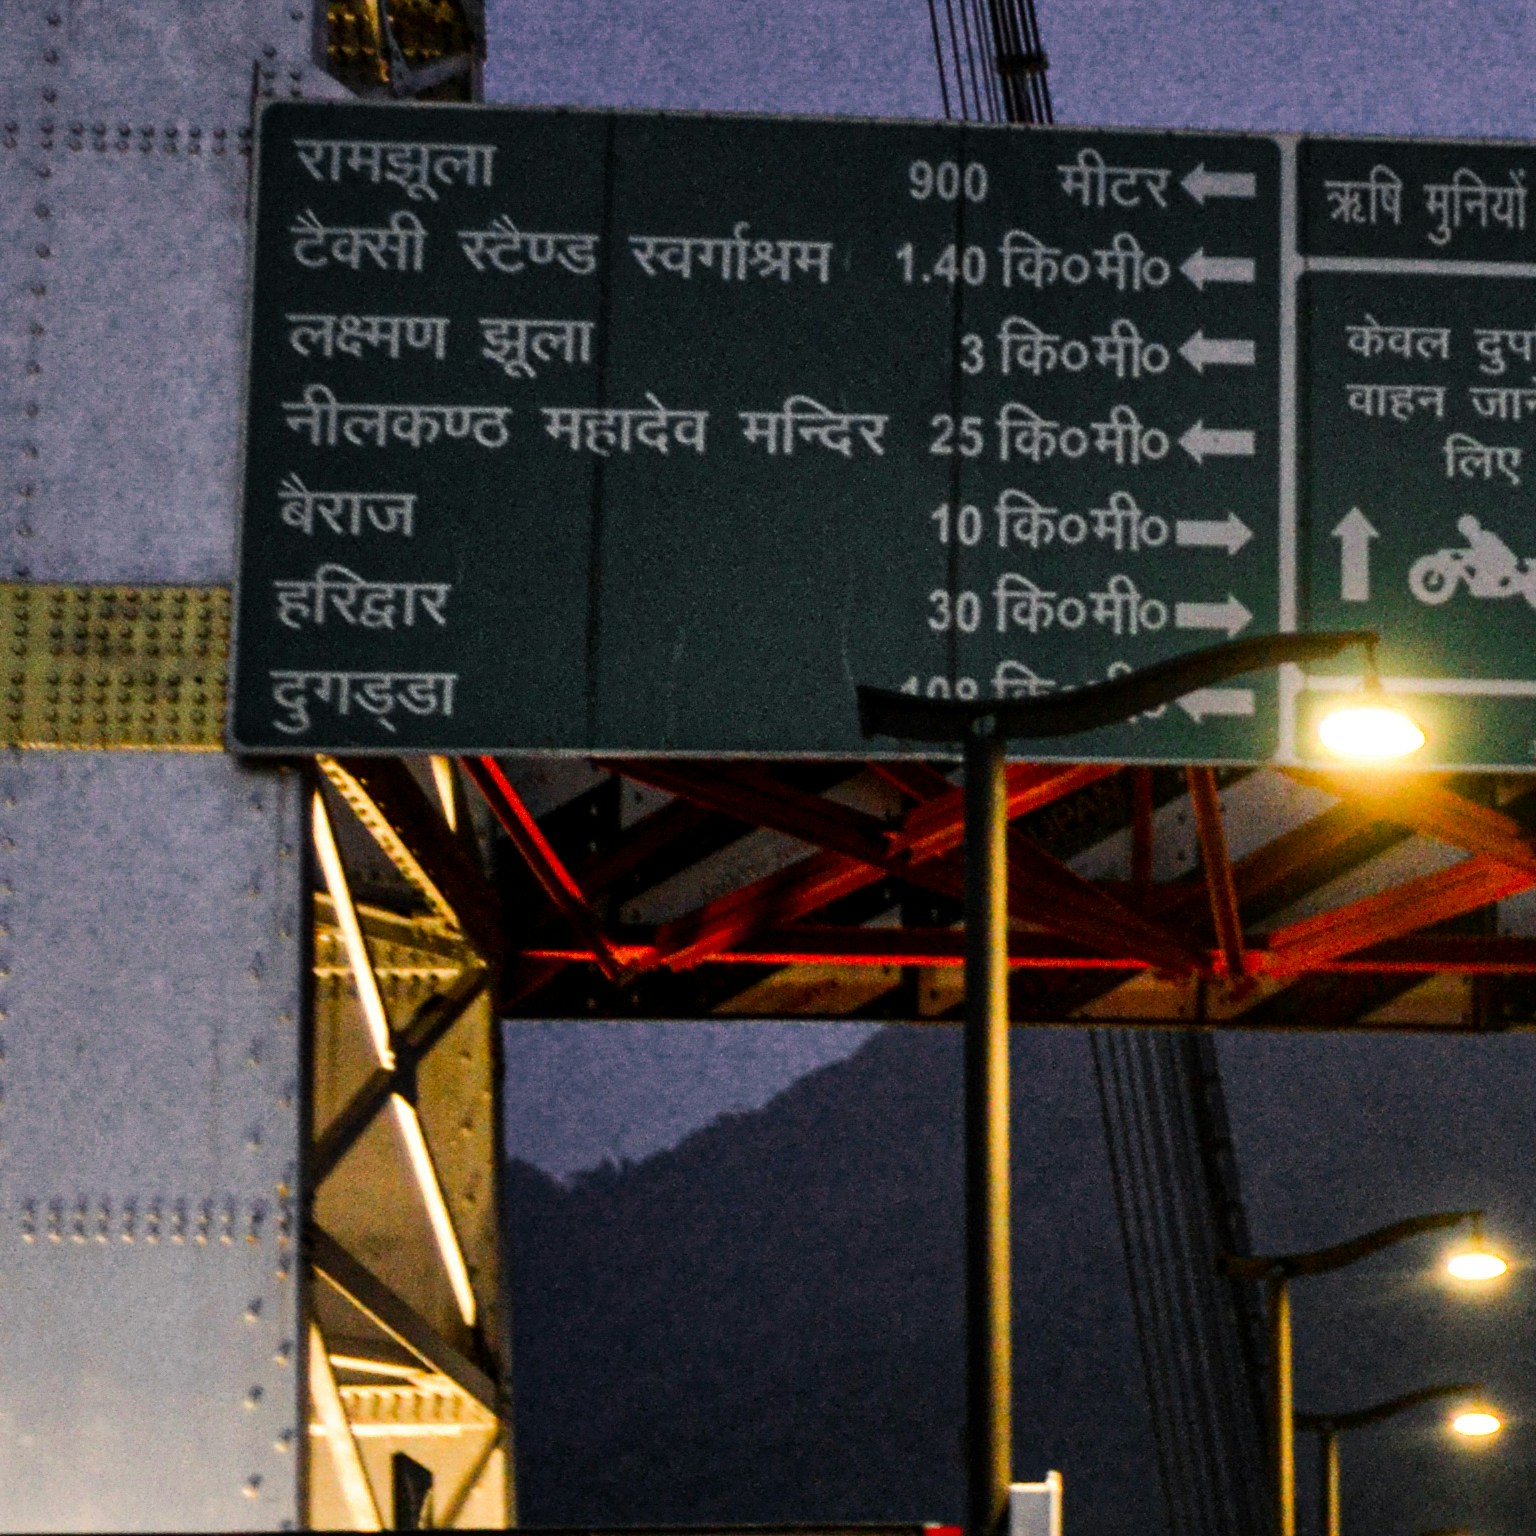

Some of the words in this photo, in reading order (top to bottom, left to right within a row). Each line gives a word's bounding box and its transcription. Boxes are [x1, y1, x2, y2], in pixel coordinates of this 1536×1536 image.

[294, 139, 498, 200] रामझूला
[910, 160, 988, 201] 900
[1058, 148, 1171, 207] मीटर
[1325, 165, 1402, 225] ऋषि
[1424, 168, 1526, 245] मुनियों
[291, 210, 427, 271] टैक्सी
[458, 213, 599, 274] स्टैण्ड
[628, 222, 833, 284] स्वर्गाश्रम
[897, 243, 986, 285] 1.40
[286, 313, 450, 360] लक्ष्मण
[480, 318, 595, 378] झूला
[961, 334, 984, 374] 3
[1345, 314, 1451, 359] केवल
[281, 384, 513, 448] नीलकण्ठ
[541, 392, 709, 455] महादेव
[739, 395, 889, 457] मन्दिर
[1345, 383, 1446, 421] वाहन
[930, 414, 983, 457] 25
[1443, 431, 1523, 486] लिए
[278, 473, 417, 536] बैराज
[931, 504, 983, 545] 10
[274, 564, 453, 628] हरिद्वार
[928, 590, 980, 632] 30
